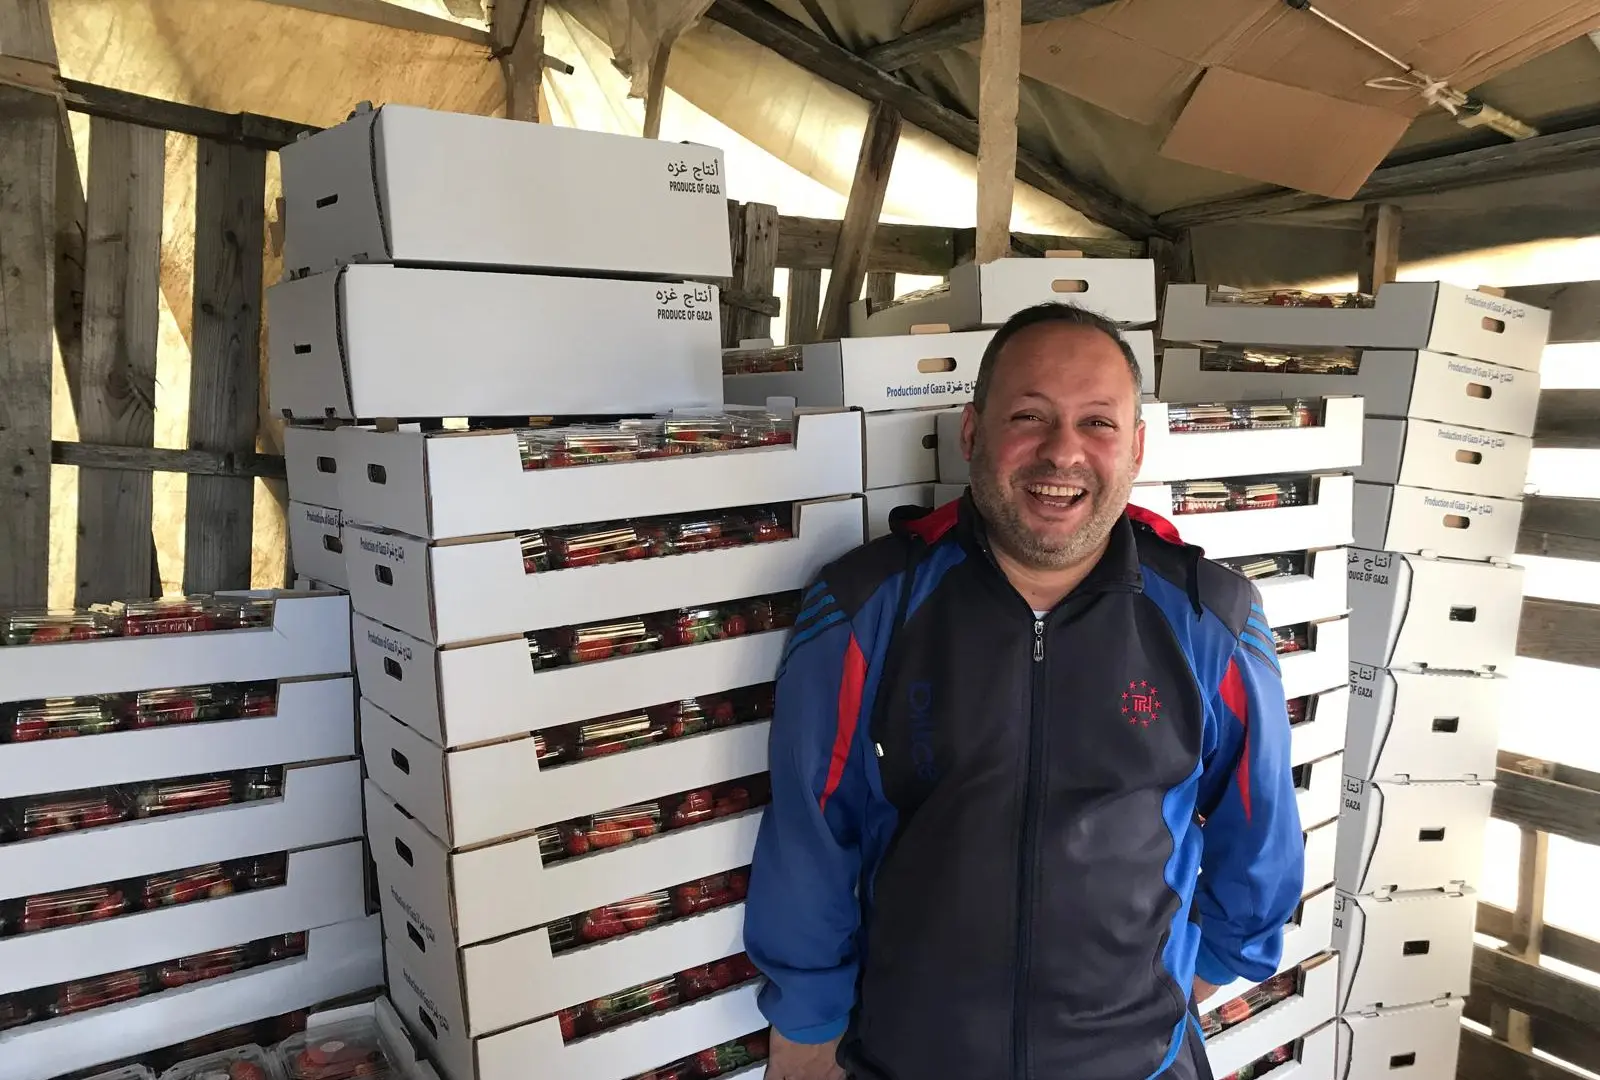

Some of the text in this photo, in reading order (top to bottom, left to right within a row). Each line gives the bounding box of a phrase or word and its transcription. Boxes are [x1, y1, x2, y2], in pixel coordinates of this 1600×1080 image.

[669, 180, 720, 194] PRODUCE OF GAZA
[657, 308, 713, 321] PRODUCE OF GAZA
[886, 382, 946, 398] Production of Gaza
[1364, 572, 1373, 582] OF
[1373, 574, 1389, 585] GAZA
[1357, 686, 1373, 698] GAZA
[1345, 798, 1361, 811] GAZA
